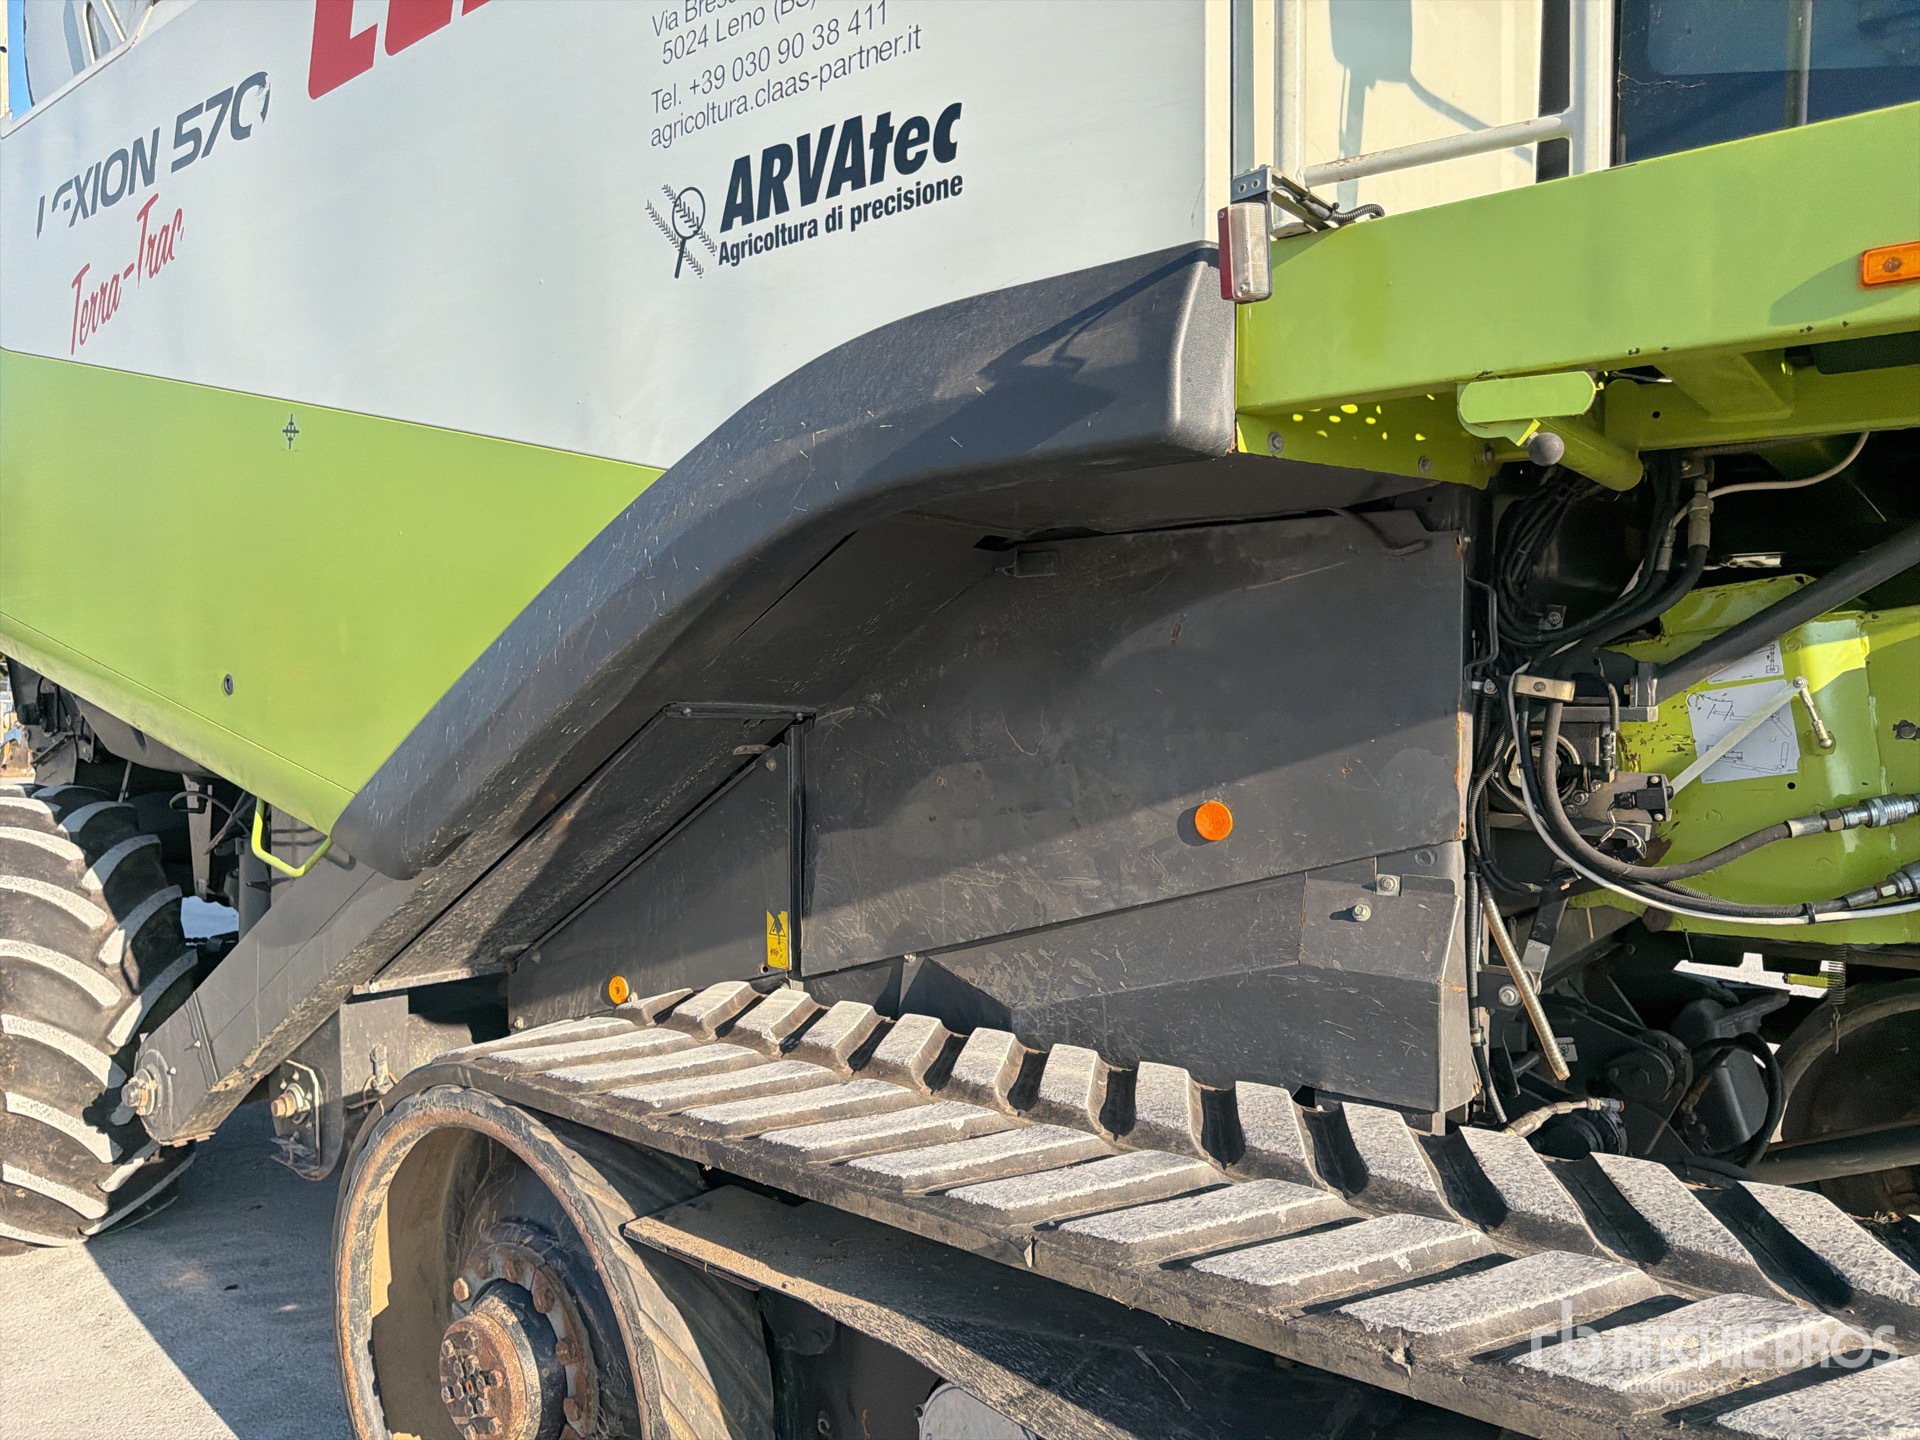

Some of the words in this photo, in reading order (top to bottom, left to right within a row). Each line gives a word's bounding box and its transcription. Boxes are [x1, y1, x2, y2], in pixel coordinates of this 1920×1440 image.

[651, 82, 682, 114] Tel.
[689, 64, 726, 96] +39
[732, 46, 770, 83] 030
[777, 32, 804, 65] 90
[812, 18, 840, 51] 38
[847, 0, 887, 36] 411
[652, 9, 679, 37] Via
[662, 24, 709, 65] 5024
[716, 7, 766, 43] Leno
[650, 24, 922, 150] agricoltura.claas-partner.it
[719, 102, 963, 234] ARVAtec
[718, 218, 819, 268] Agricoltura
[825, 205, 844, 234] di
[850, 175, 964, 233] precisione
